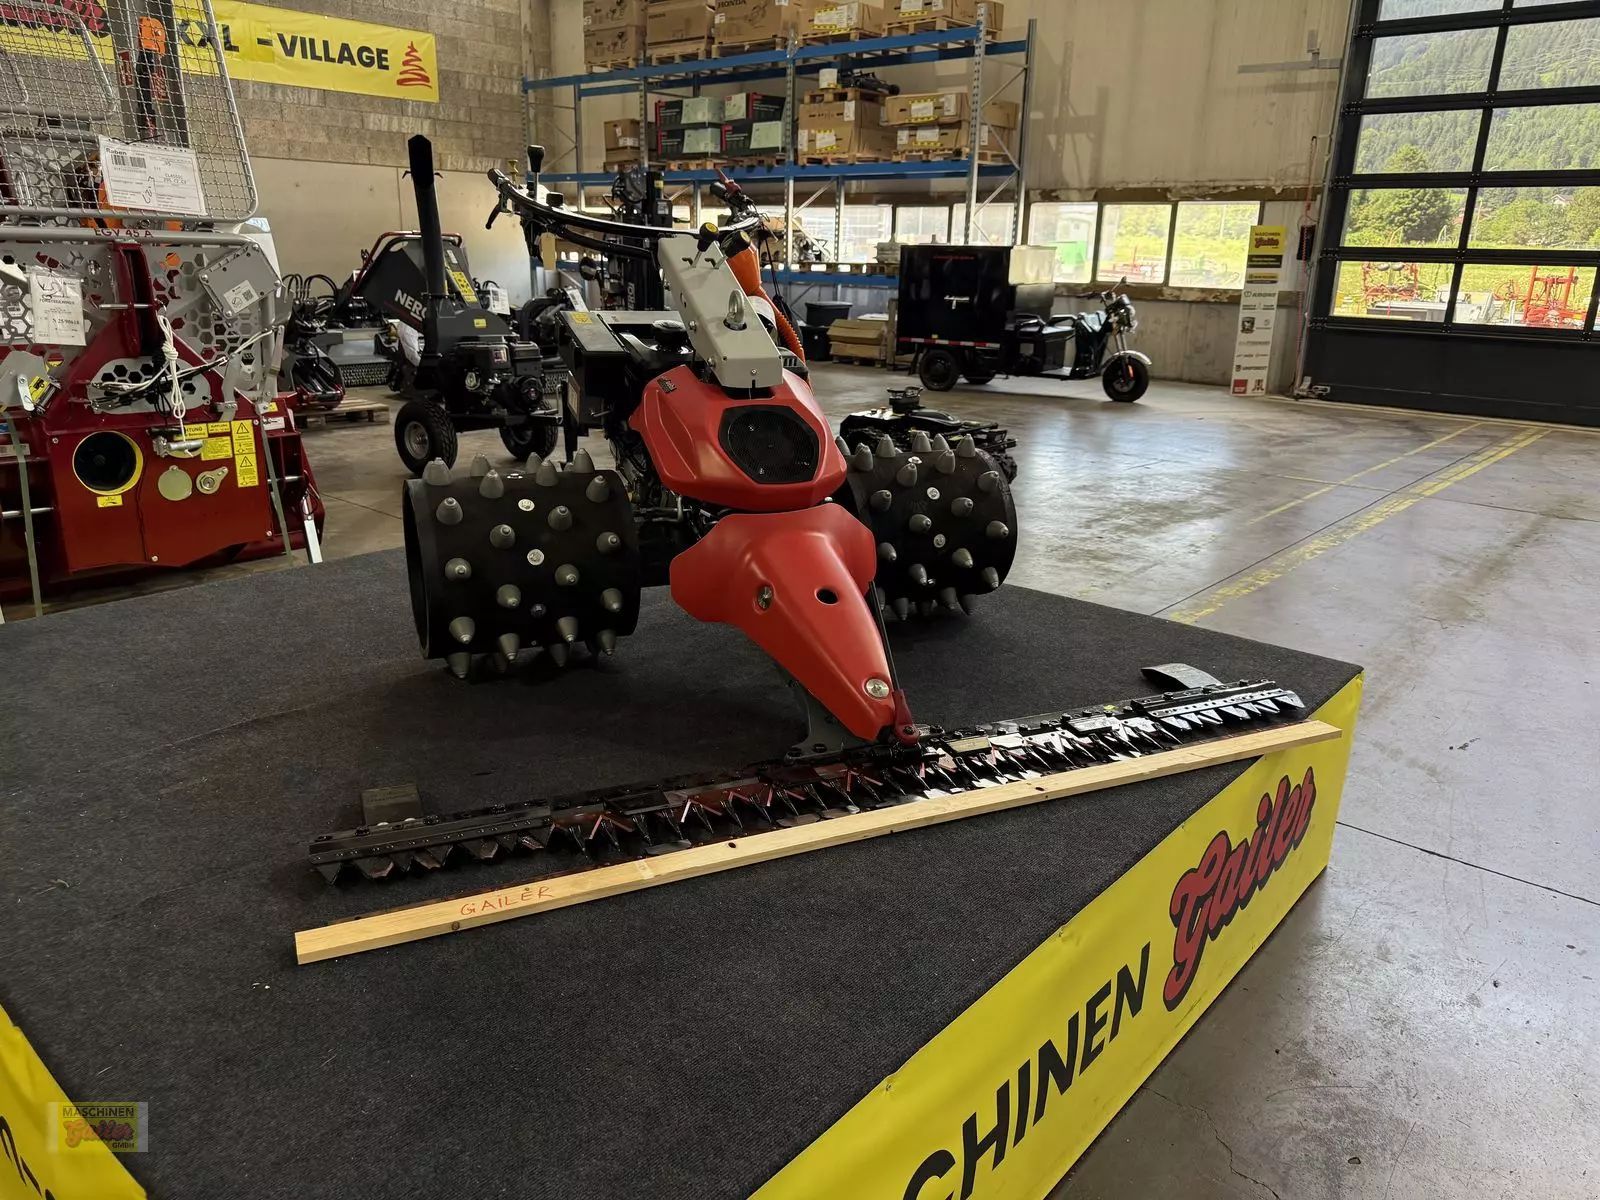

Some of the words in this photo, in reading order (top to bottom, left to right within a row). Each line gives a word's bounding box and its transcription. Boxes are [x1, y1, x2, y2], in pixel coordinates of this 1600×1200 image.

[125, 229, 140, 238] 45
[144, 230, 154, 238] A
[460, 886, 553, 916] GAILER
[1162, 765, 1317, 1012] Gailer
